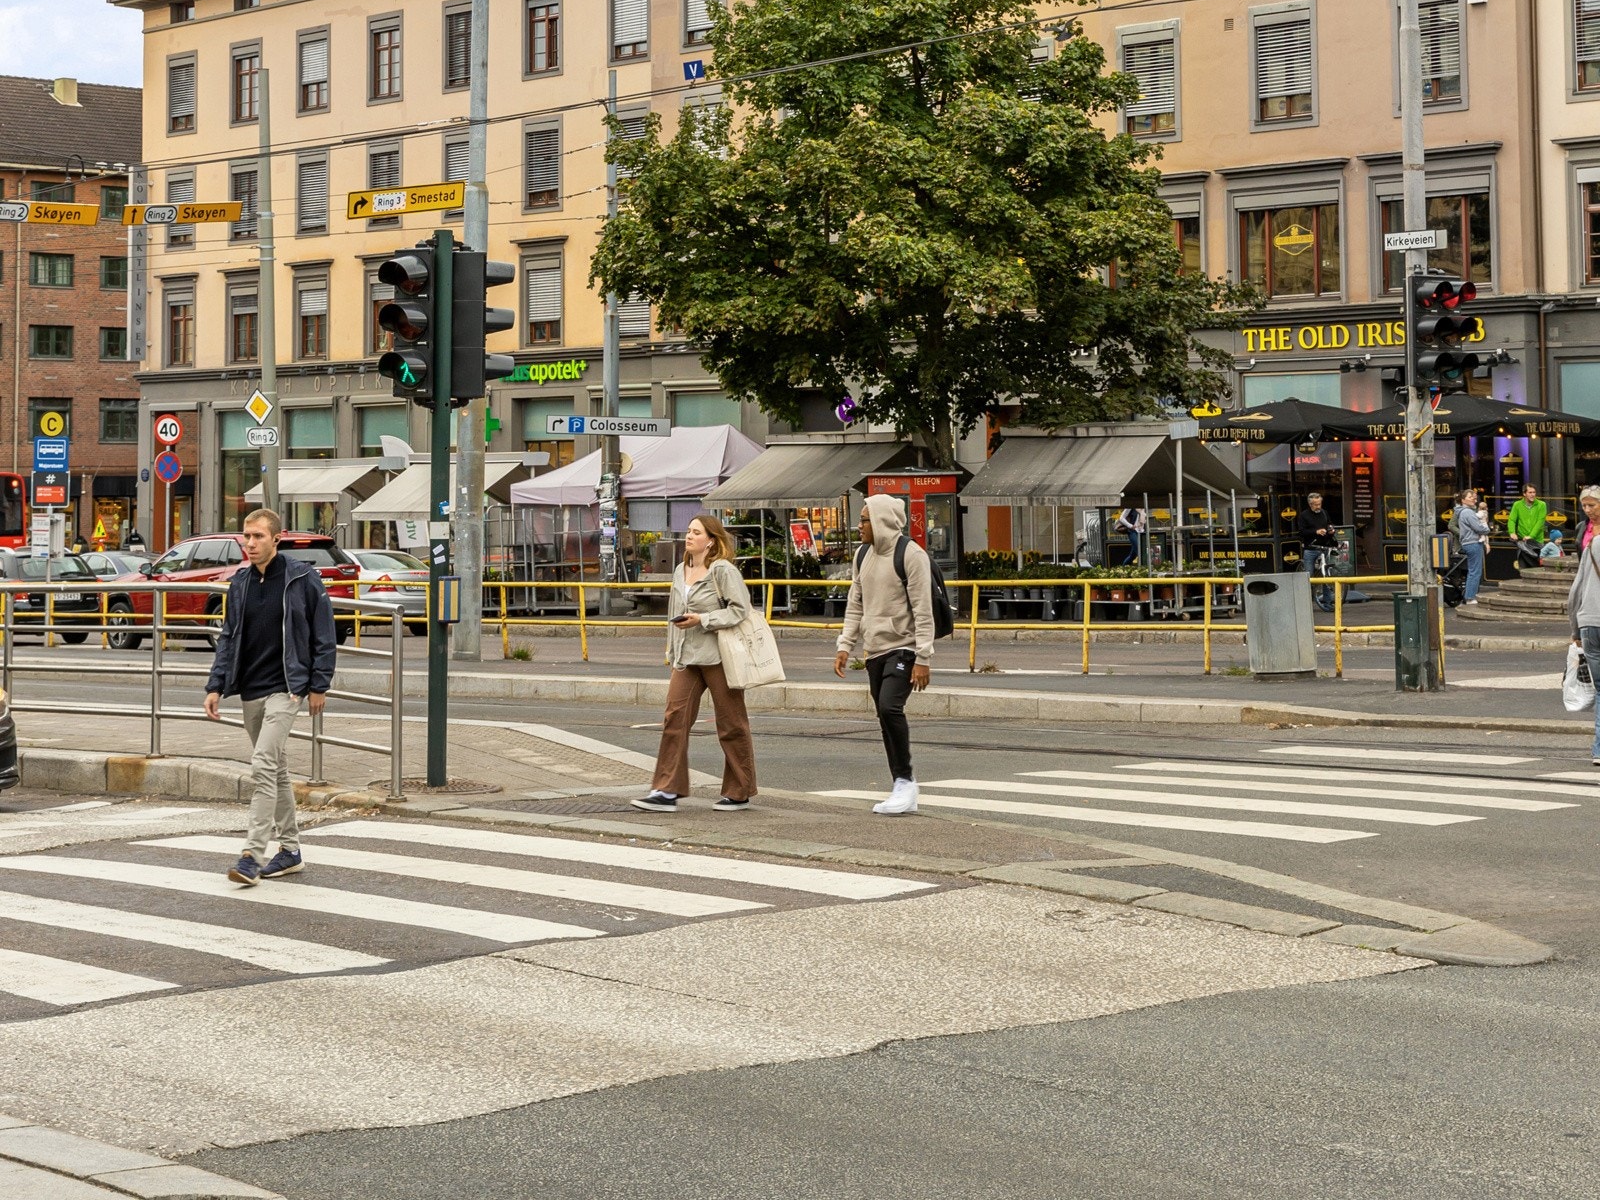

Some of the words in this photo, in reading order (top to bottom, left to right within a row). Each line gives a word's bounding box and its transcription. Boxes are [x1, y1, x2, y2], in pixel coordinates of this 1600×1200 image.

[377, 197, 395, 208] Ring
[396, 196, 402, 205] 3
[410, 190, 456, 205] Smestad
[17, 207, 25, 218] 2
[34, 206, 81, 220] Skøyen
[147, 207, 166, 221] Ring
[167, 207, 175, 220] 2
[182, 207, 226, 219] Skøyen
[1386, 234, 1434, 247] Kirkeveien
[136, 171, 144, 356] KOAKTLINSER
[1242, 327, 1293, 352] THE
[1298, 324, 1349, 350] OLD
[1357, 321, 1405, 347] IRIS
[230, 378, 292, 396] KROH
[47, 417, 57, 432] C
[160, 423, 178, 437] 40
[590, 419, 658, 432] Colosseum
[1367, 424, 1384, 436] THE
[1386, 423, 1405, 435] OLD
[1433, 423, 1450, 435] PUB
[1525, 422, 1538, 434] THE
[1539, 421, 1552, 433] OLD
[1568, 422, 1581, 434] PUB
[250, 432, 267, 443] Ring
[268, 431, 275, 442] 2
[1199, 428, 1212, 439] THE
[1213, 428, 1229, 439] OLD
[1230, 428, 1249, 440] IRISH
[1250, 428, 1266, 440] PUB
[872, 478, 896, 486] TELEFON
[913, 477, 941, 486] TELEFON
[1199, 551, 1209, 559] LIVE
[1227, 551, 1255, 559] PARYBANDS
